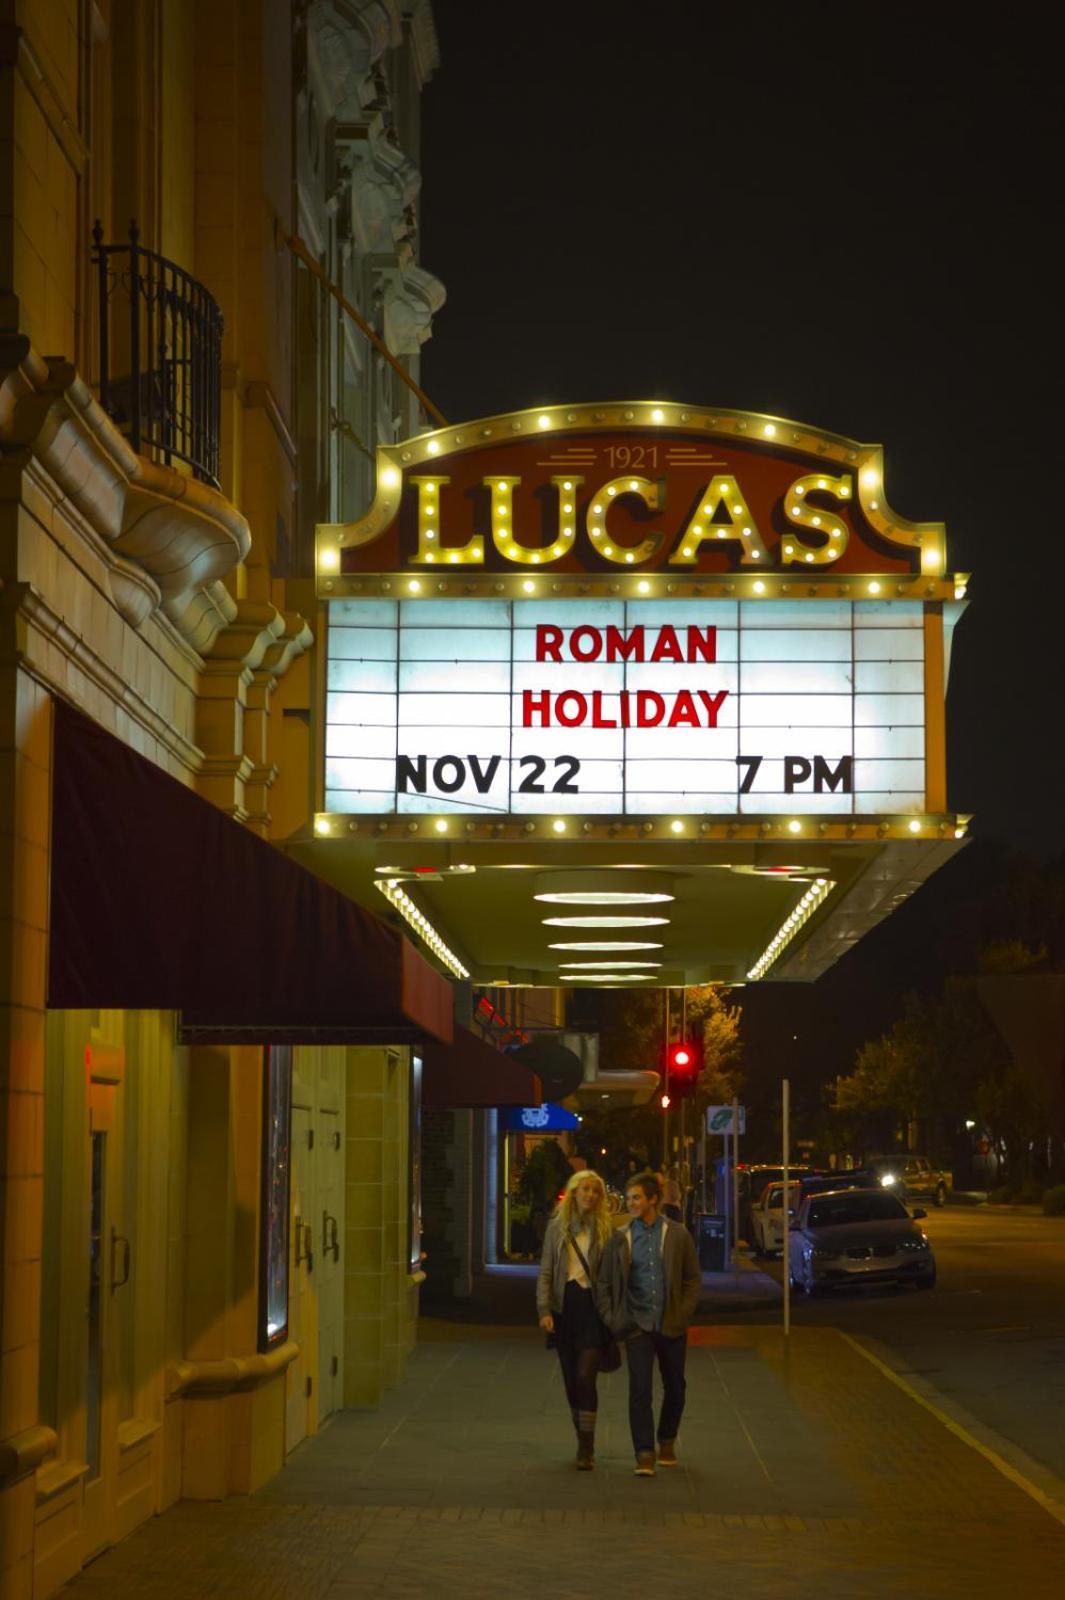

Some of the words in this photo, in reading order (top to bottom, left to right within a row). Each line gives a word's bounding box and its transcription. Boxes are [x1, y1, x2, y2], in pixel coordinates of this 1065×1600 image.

[602, 446, 659, 469] 1921
[408, 474, 852, 565] LUCAS
[535, 624, 717, 663] ROMAN
[522, 690, 729, 728] HOLIDAY
[397, 754, 502, 794] NOV
[518, 754, 581, 793] 22
[736, 755, 763, 794] 7
[784, 755, 853, 793] PM
